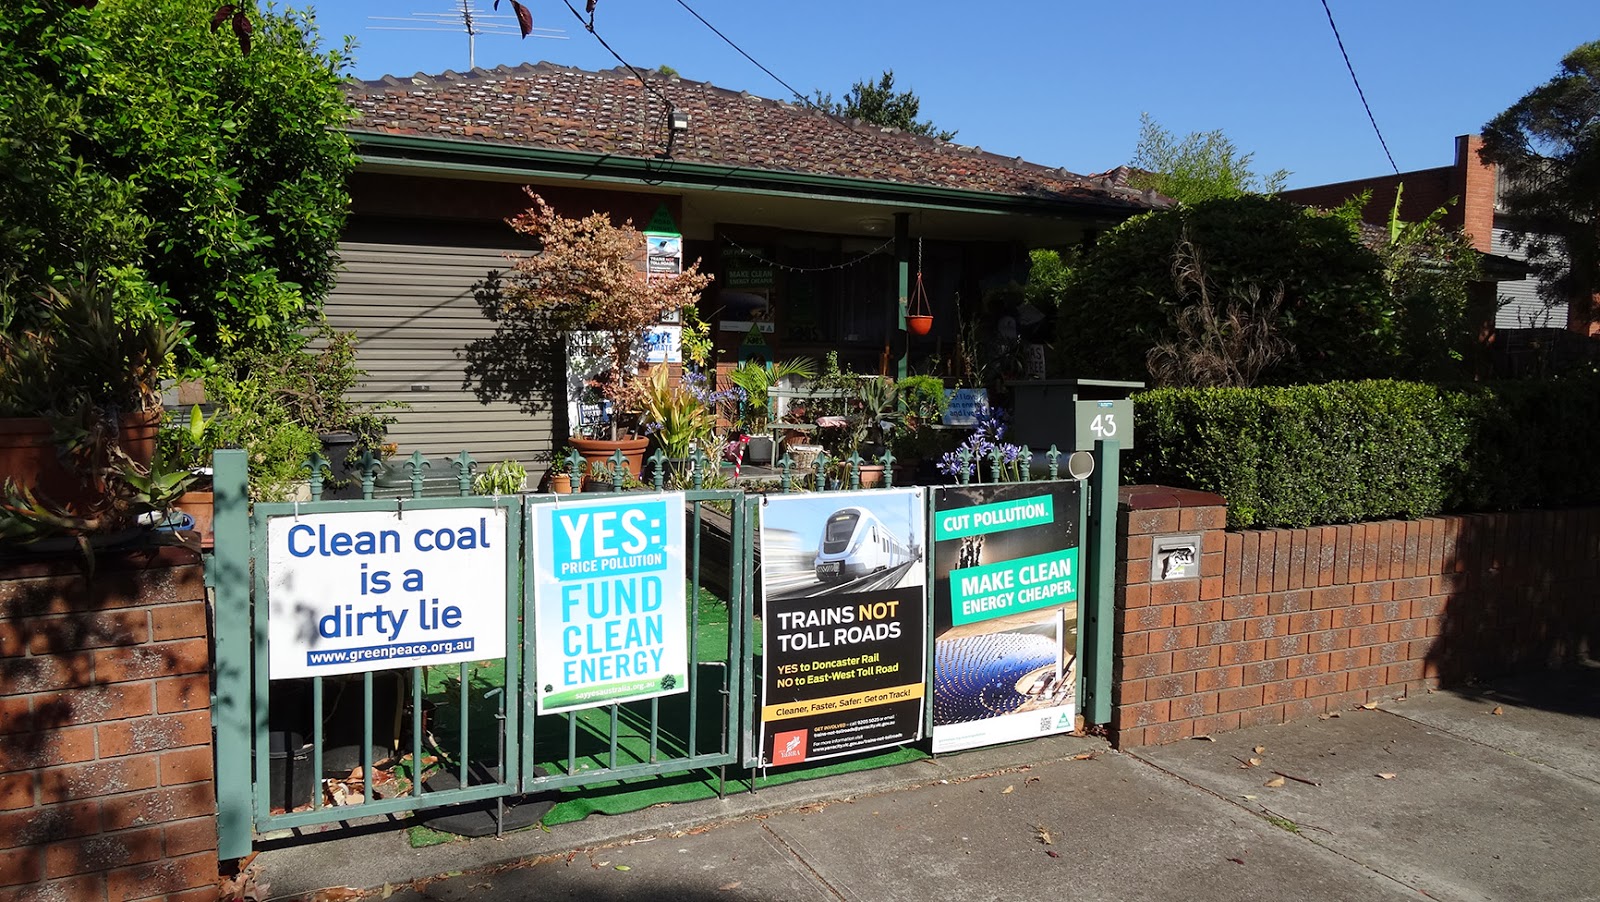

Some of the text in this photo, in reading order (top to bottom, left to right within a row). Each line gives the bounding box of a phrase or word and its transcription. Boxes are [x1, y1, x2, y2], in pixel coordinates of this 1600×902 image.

[1090, 414, 1116, 437] 43
[943, 503, 1048, 532] CUT POLLUTION.
[288, 518, 490, 558] Clean coal
[560, 508, 660, 560] YES:
[361, 563, 424, 595] is a
[562, 554, 662, 575] PRICE POLLUTION
[961, 558, 1071, 597] MAKE CLEAN
[562, 576, 662, 622] FUND
[962, 581, 1075, 615] ENERGY CHEAPER.
[319, 598, 462, 641] dirty lie
[777, 600, 899, 630] TRAINS NOT
[563, 614, 662, 658] CLEAN
[777, 622, 901, 652] TOLL ROADS
[310, 641, 472, 664] www.greenpeace.org.au
[564, 647, 664, 686] ENERGY
[777, 653, 879, 675] YES to Doncaster Rail
[777, 662, 899, 688] NO to East-West Toll Road
[575, 681, 656, 700] sayyesaustralia.org.au
[776, 706, 809, 717] Cleaner,
[811, 702, 838, 712] Faster,
[839, 697, 862, 707] Safer:
[864, 694, 877, 703] Get
[889, 689, 911, 699] Track!
